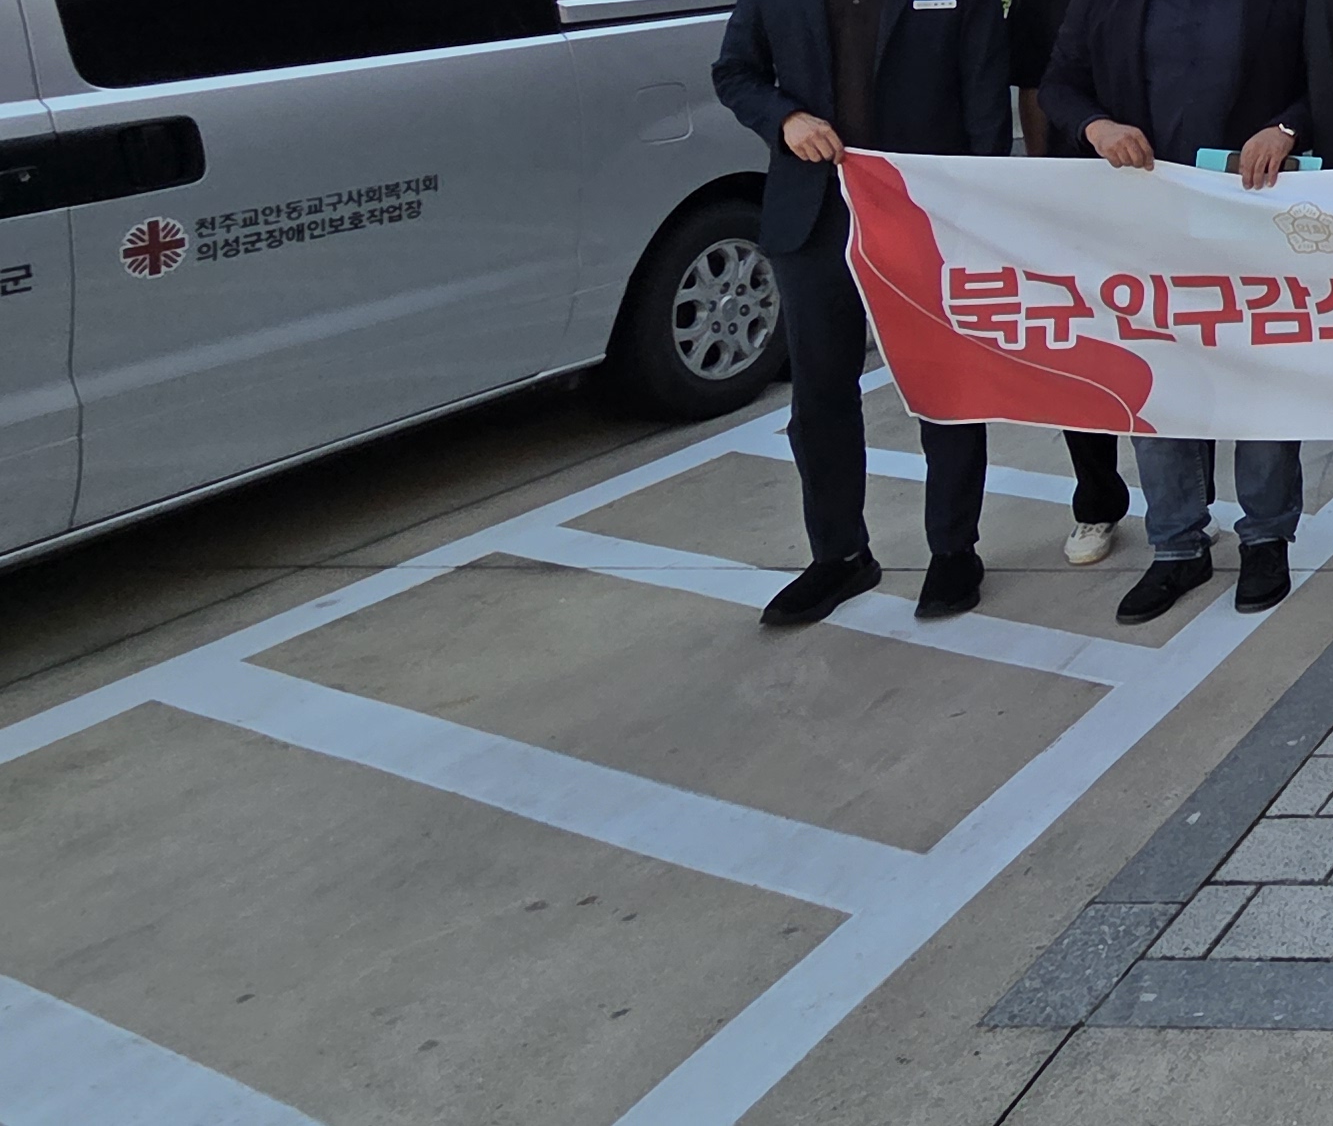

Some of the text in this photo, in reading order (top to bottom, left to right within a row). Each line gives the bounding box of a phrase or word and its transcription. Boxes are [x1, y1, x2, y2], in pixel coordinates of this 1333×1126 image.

[194, 174, 440, 238] 천주교안동교구사회복지회
[196, 199, 424, 262] 의성군장애인보호작업장
[949, 266, 1095, 346] 북구
